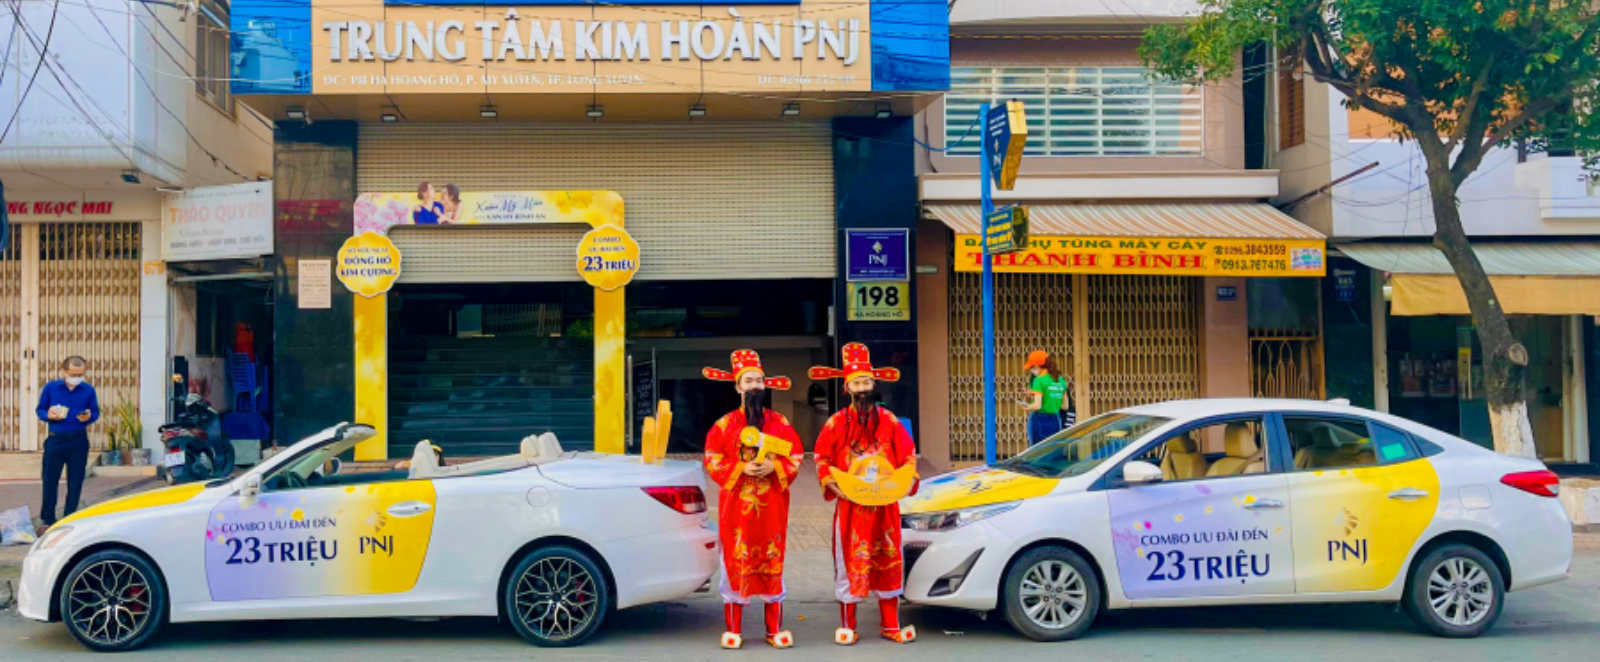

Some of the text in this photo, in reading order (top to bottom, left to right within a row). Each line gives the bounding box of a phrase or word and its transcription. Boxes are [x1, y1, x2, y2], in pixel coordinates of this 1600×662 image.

[323, 6, 860, 66] TRUNG TÂM KIM HOÀN PNJ
[351, 75, 368, 86] 198
[467, 75, 477, 86] P.
[6, 201, 113, 217] NG NGỌC MAI
[170, 202, 211, 224] THẢO
[1058, 238, 1112, 248] TÙNG
[583, 256, 635, 272] 23 TRIỆU
[869, 254, 888, 267] PNJ
[967, 250, 1205, 268] THANH BÌNH
[1221, 259, 1286, 271] 0913.767476
[341, 268, 358, 276] KIM
[858, 286, 899, 307] 198
[221, 521, 266, 533] COMBO
[269, 519, 287, 531] ƯU
[313, 515, 337, 528] ĐẾN
[1141, 526, 1269, 547] COMBO ƯU ĐÃI ĐẾN
[225, 535, 338, 567] 23 TRIỆU
[359, 535, 394, 558] PNJ
[1327, 539, 1368, 565] PNJ
[1146, 549, 1270, 585] 23 TRIỆU
